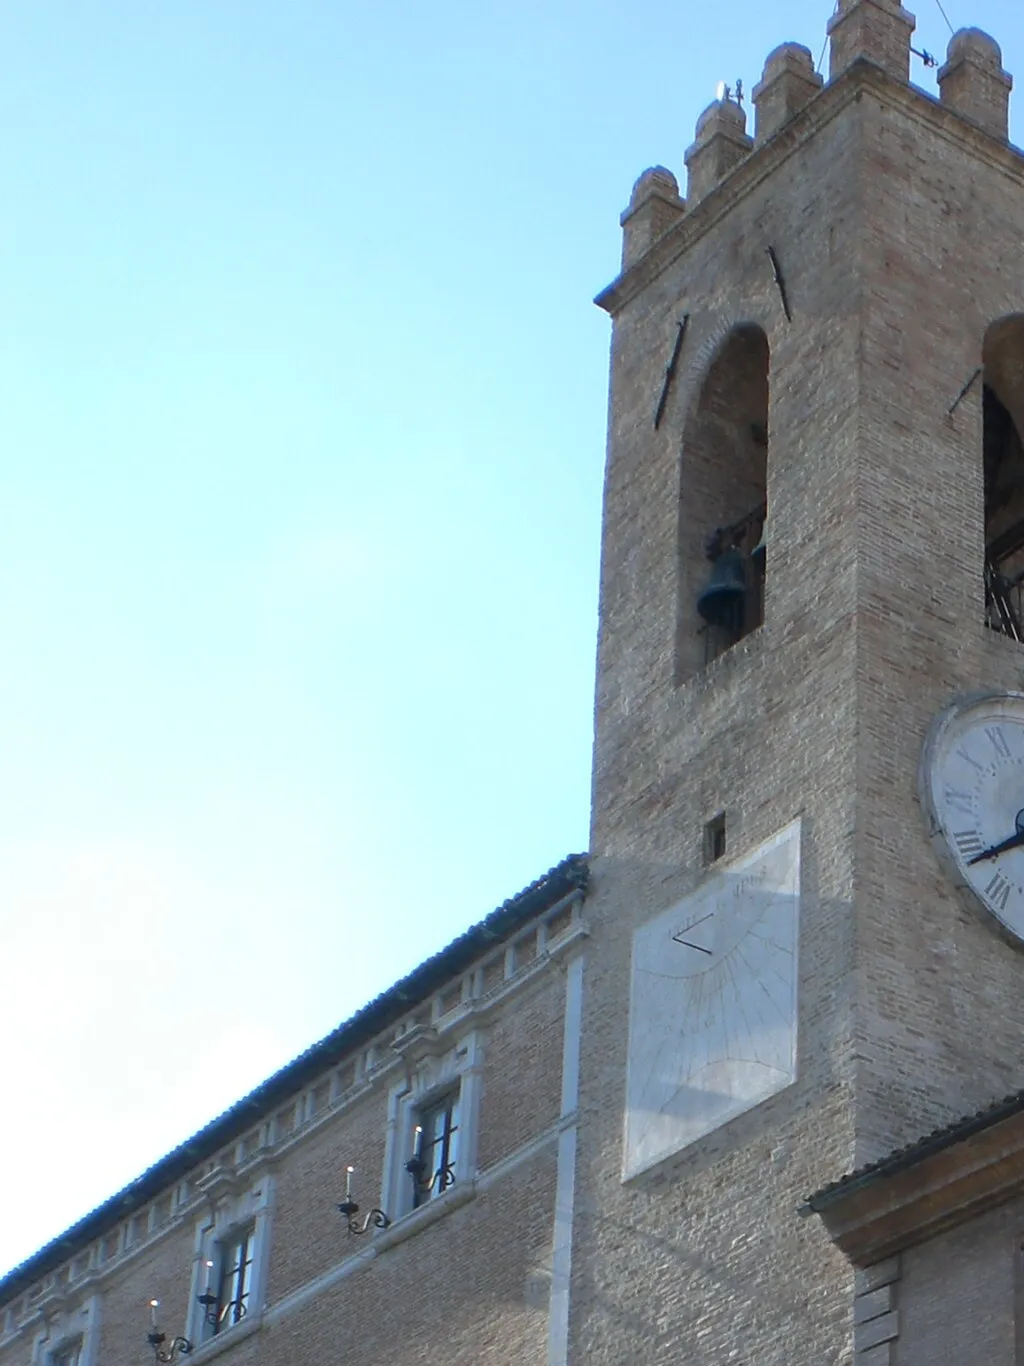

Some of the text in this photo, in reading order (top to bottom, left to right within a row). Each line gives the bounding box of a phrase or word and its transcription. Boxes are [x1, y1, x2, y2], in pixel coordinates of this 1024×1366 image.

[956, 744, 984, 772] X
[984, 726, 1012, 759] XI
[984, 871, 1011, 910] VII
